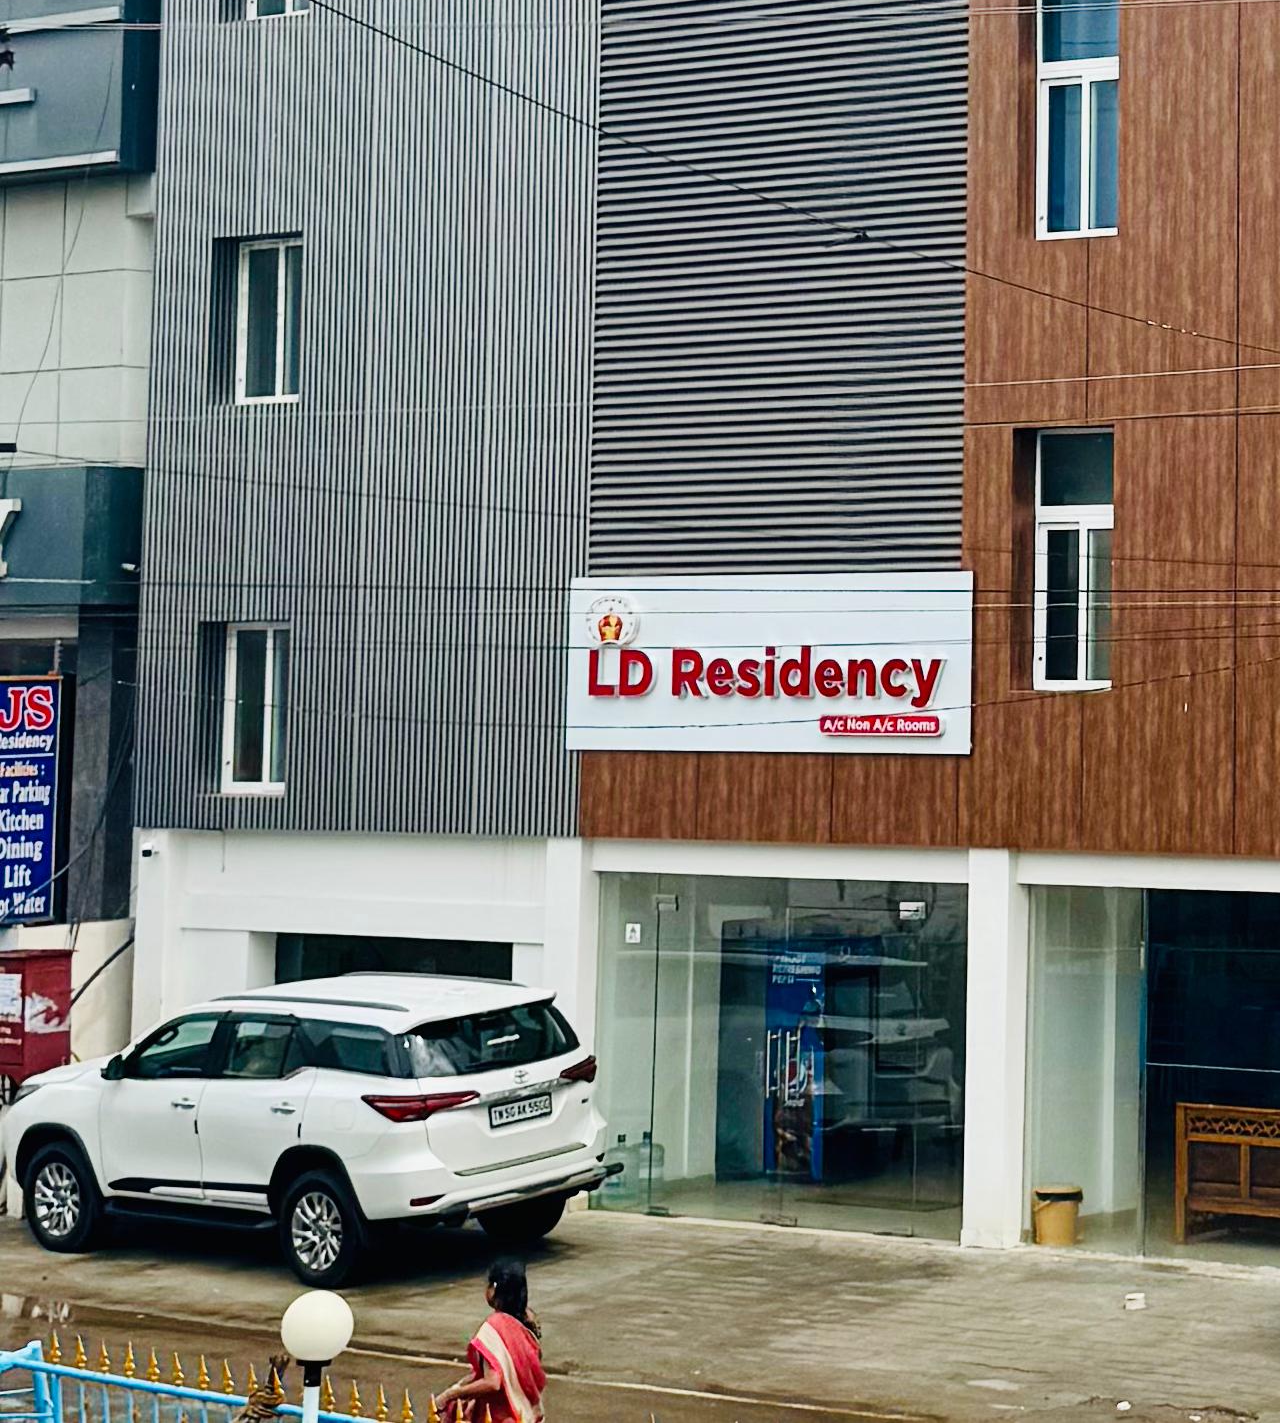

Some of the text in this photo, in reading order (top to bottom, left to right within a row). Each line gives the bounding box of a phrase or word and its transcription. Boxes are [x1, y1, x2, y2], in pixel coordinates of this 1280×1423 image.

[588, 645, 946, 709] LD Residency
[823, 717, 936, 732] A/c Non A/c Rooms
[0, 732, 54, 752] esidency
[12, 780, 51, 806] Parking
[4, 864, 31, 888] Lift
[13, 891, 46, 914] Water
